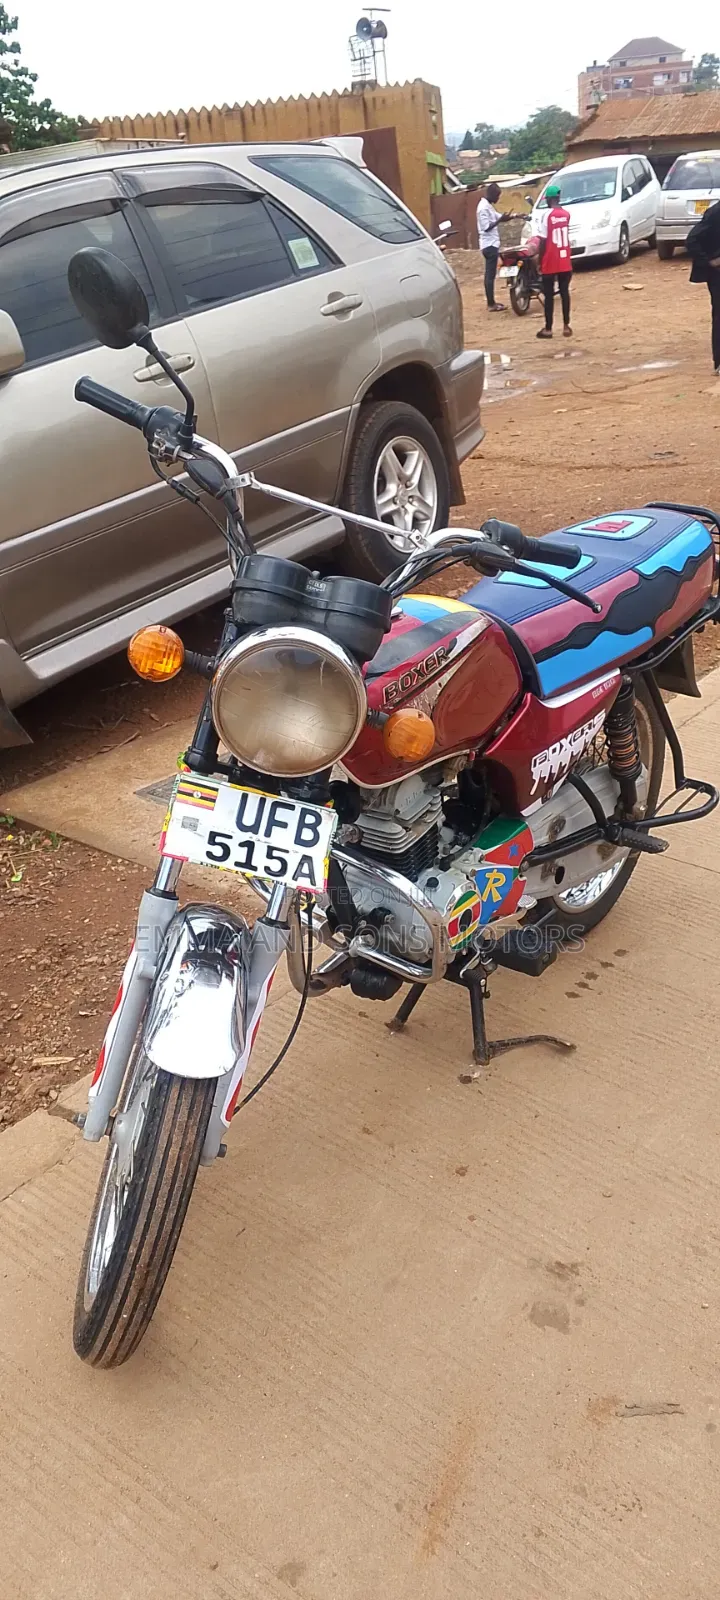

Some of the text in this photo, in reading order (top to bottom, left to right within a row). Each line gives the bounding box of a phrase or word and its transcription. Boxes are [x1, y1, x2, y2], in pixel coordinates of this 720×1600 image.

[383, 645, 450, 705] BOXER
[235, 792, 323, 848] UFB
[205, 830, 317, 887] 515A
[481, 868, 506, 903] R
